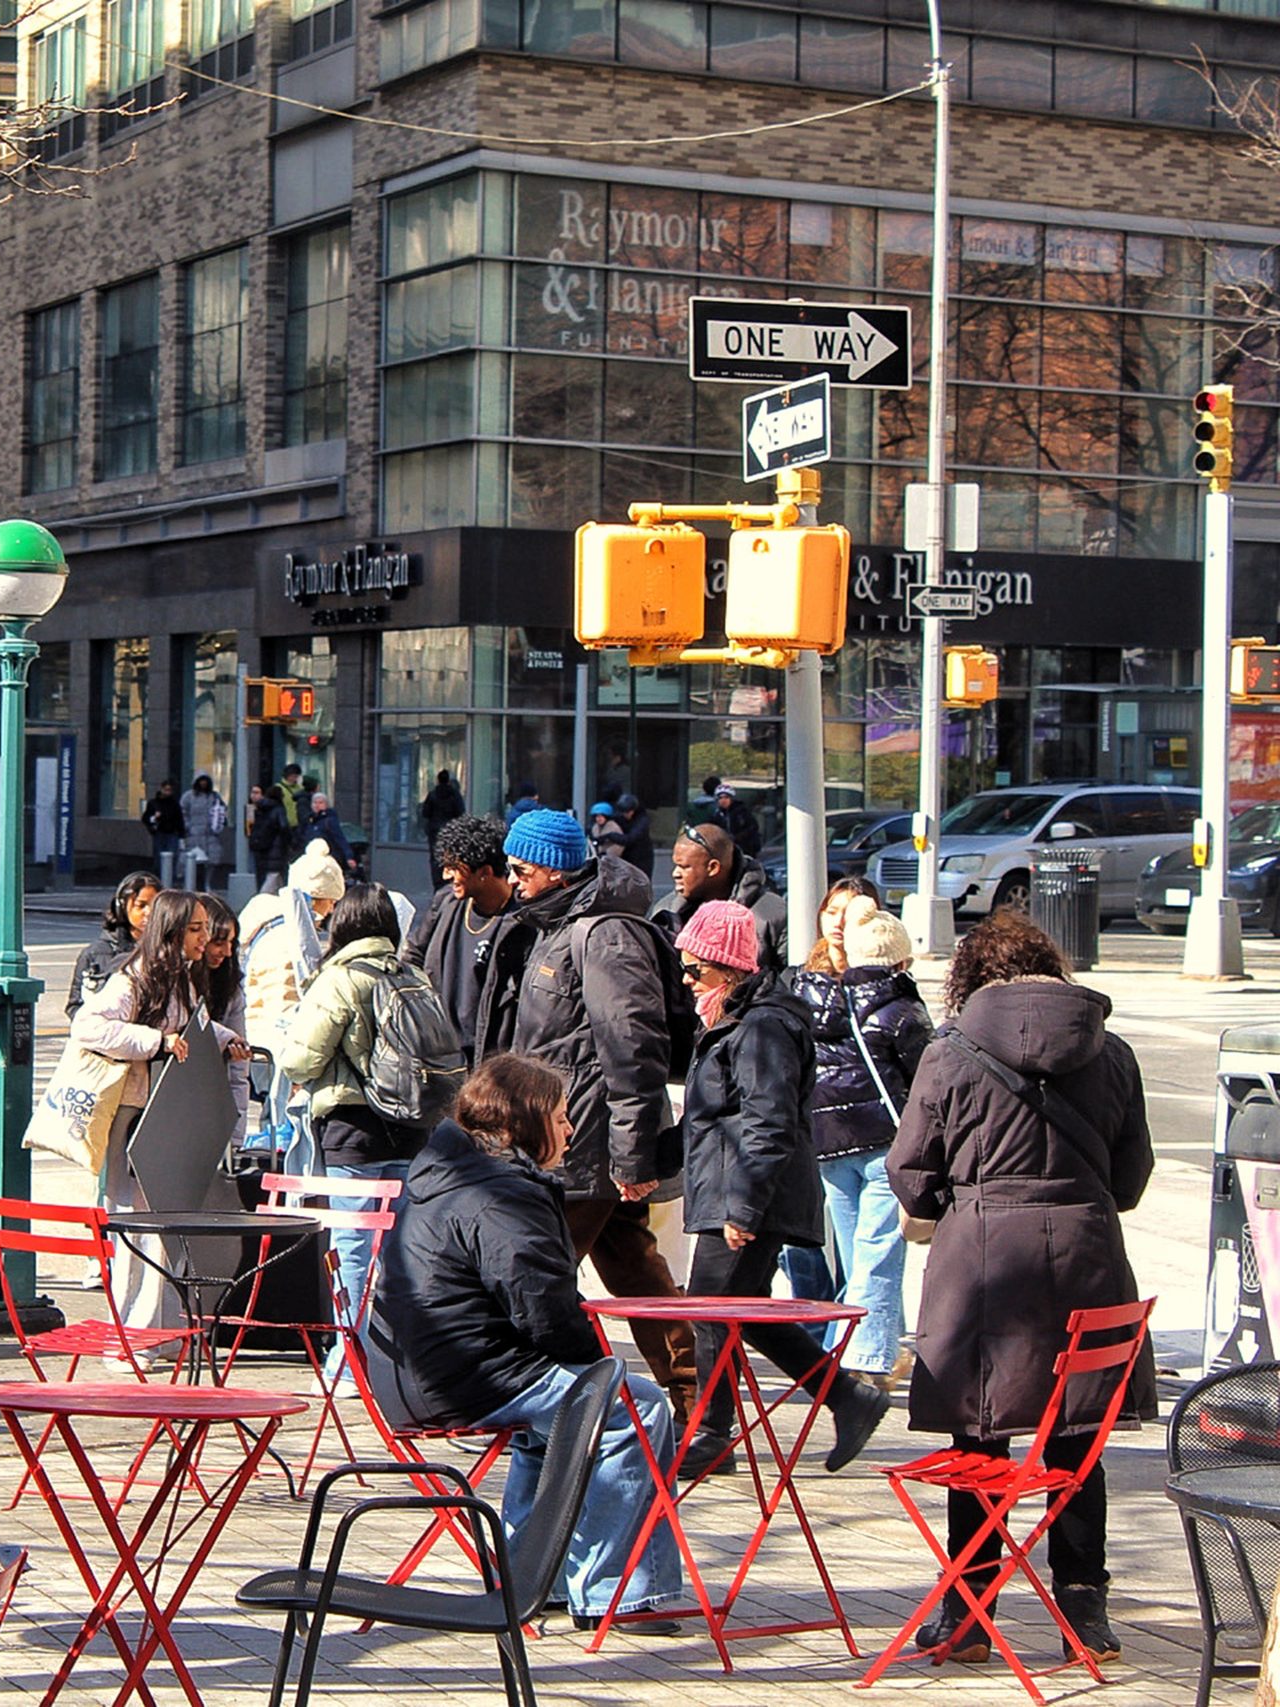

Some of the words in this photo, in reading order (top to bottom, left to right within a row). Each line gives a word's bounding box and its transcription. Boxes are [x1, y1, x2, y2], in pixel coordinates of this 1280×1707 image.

[542, 247, 585, 322] &
[723, 325, 784, 357] ONE
[814, 330, 876, 362] WAY
[284, 552, 338, 607] Raymour
[340, 550, 352, 597] &
[354, 543, 410, 601] Flanigan
[854, 554, 881, 605] &
[892, 552, 1034, 616] Flnigan
[921, 595, 941, 607] ONE
[949, 595, 970, 607] WAY
[301, 691, 312, 716] 8
[65, 1086, 97, 1107] BOS
[68, 1103, 94, 1117] TON
